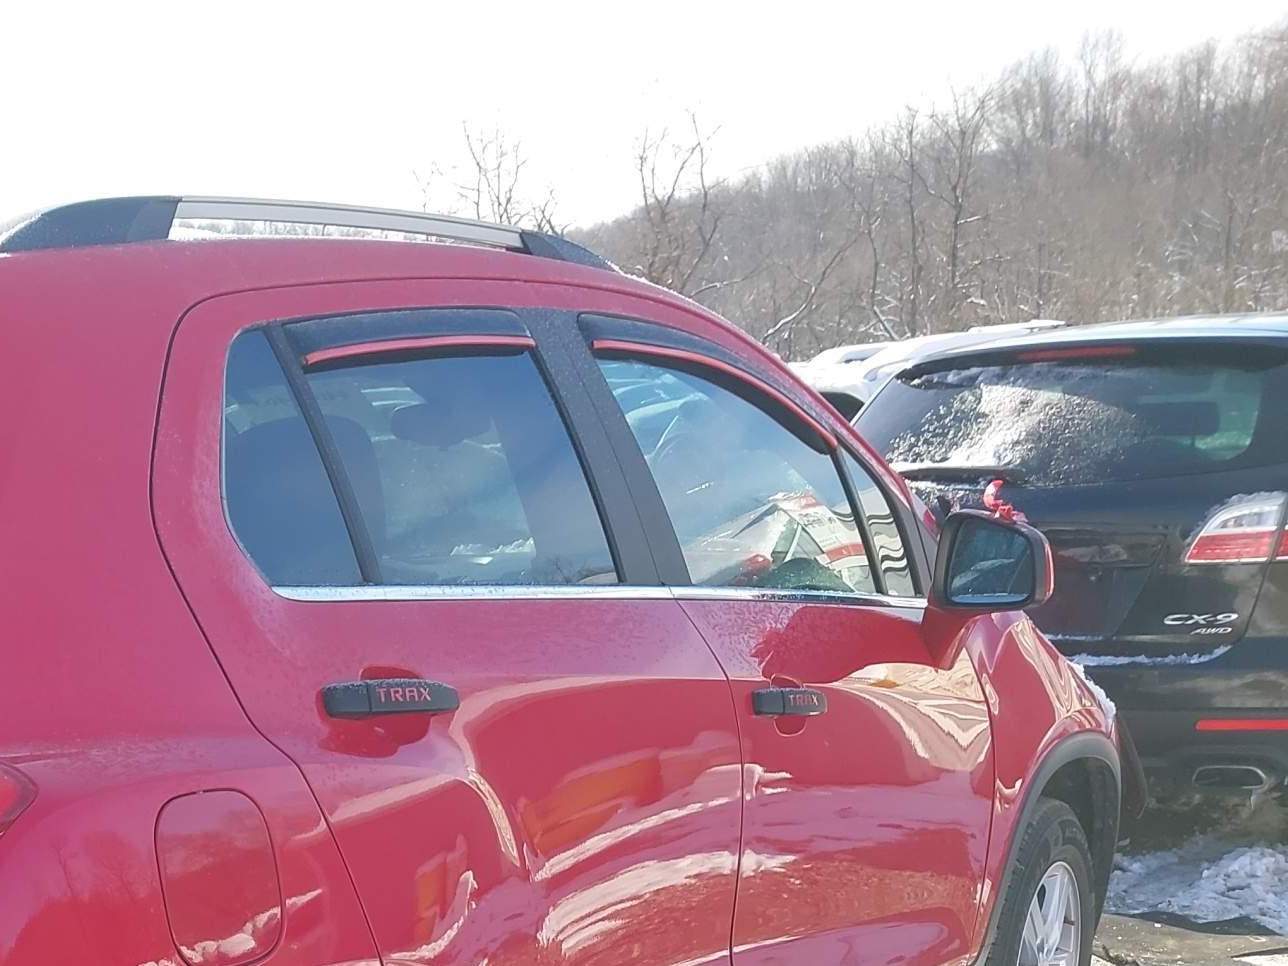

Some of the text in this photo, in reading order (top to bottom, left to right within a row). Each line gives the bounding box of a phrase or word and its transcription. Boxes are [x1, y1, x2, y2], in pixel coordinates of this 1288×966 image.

[1163, 612, 1239, 625] CX-9
[1190, 626, 1233, 635] AWD
[376, 687, 431, 702] TRAX
[789, 694, 818, 706] TRAX
